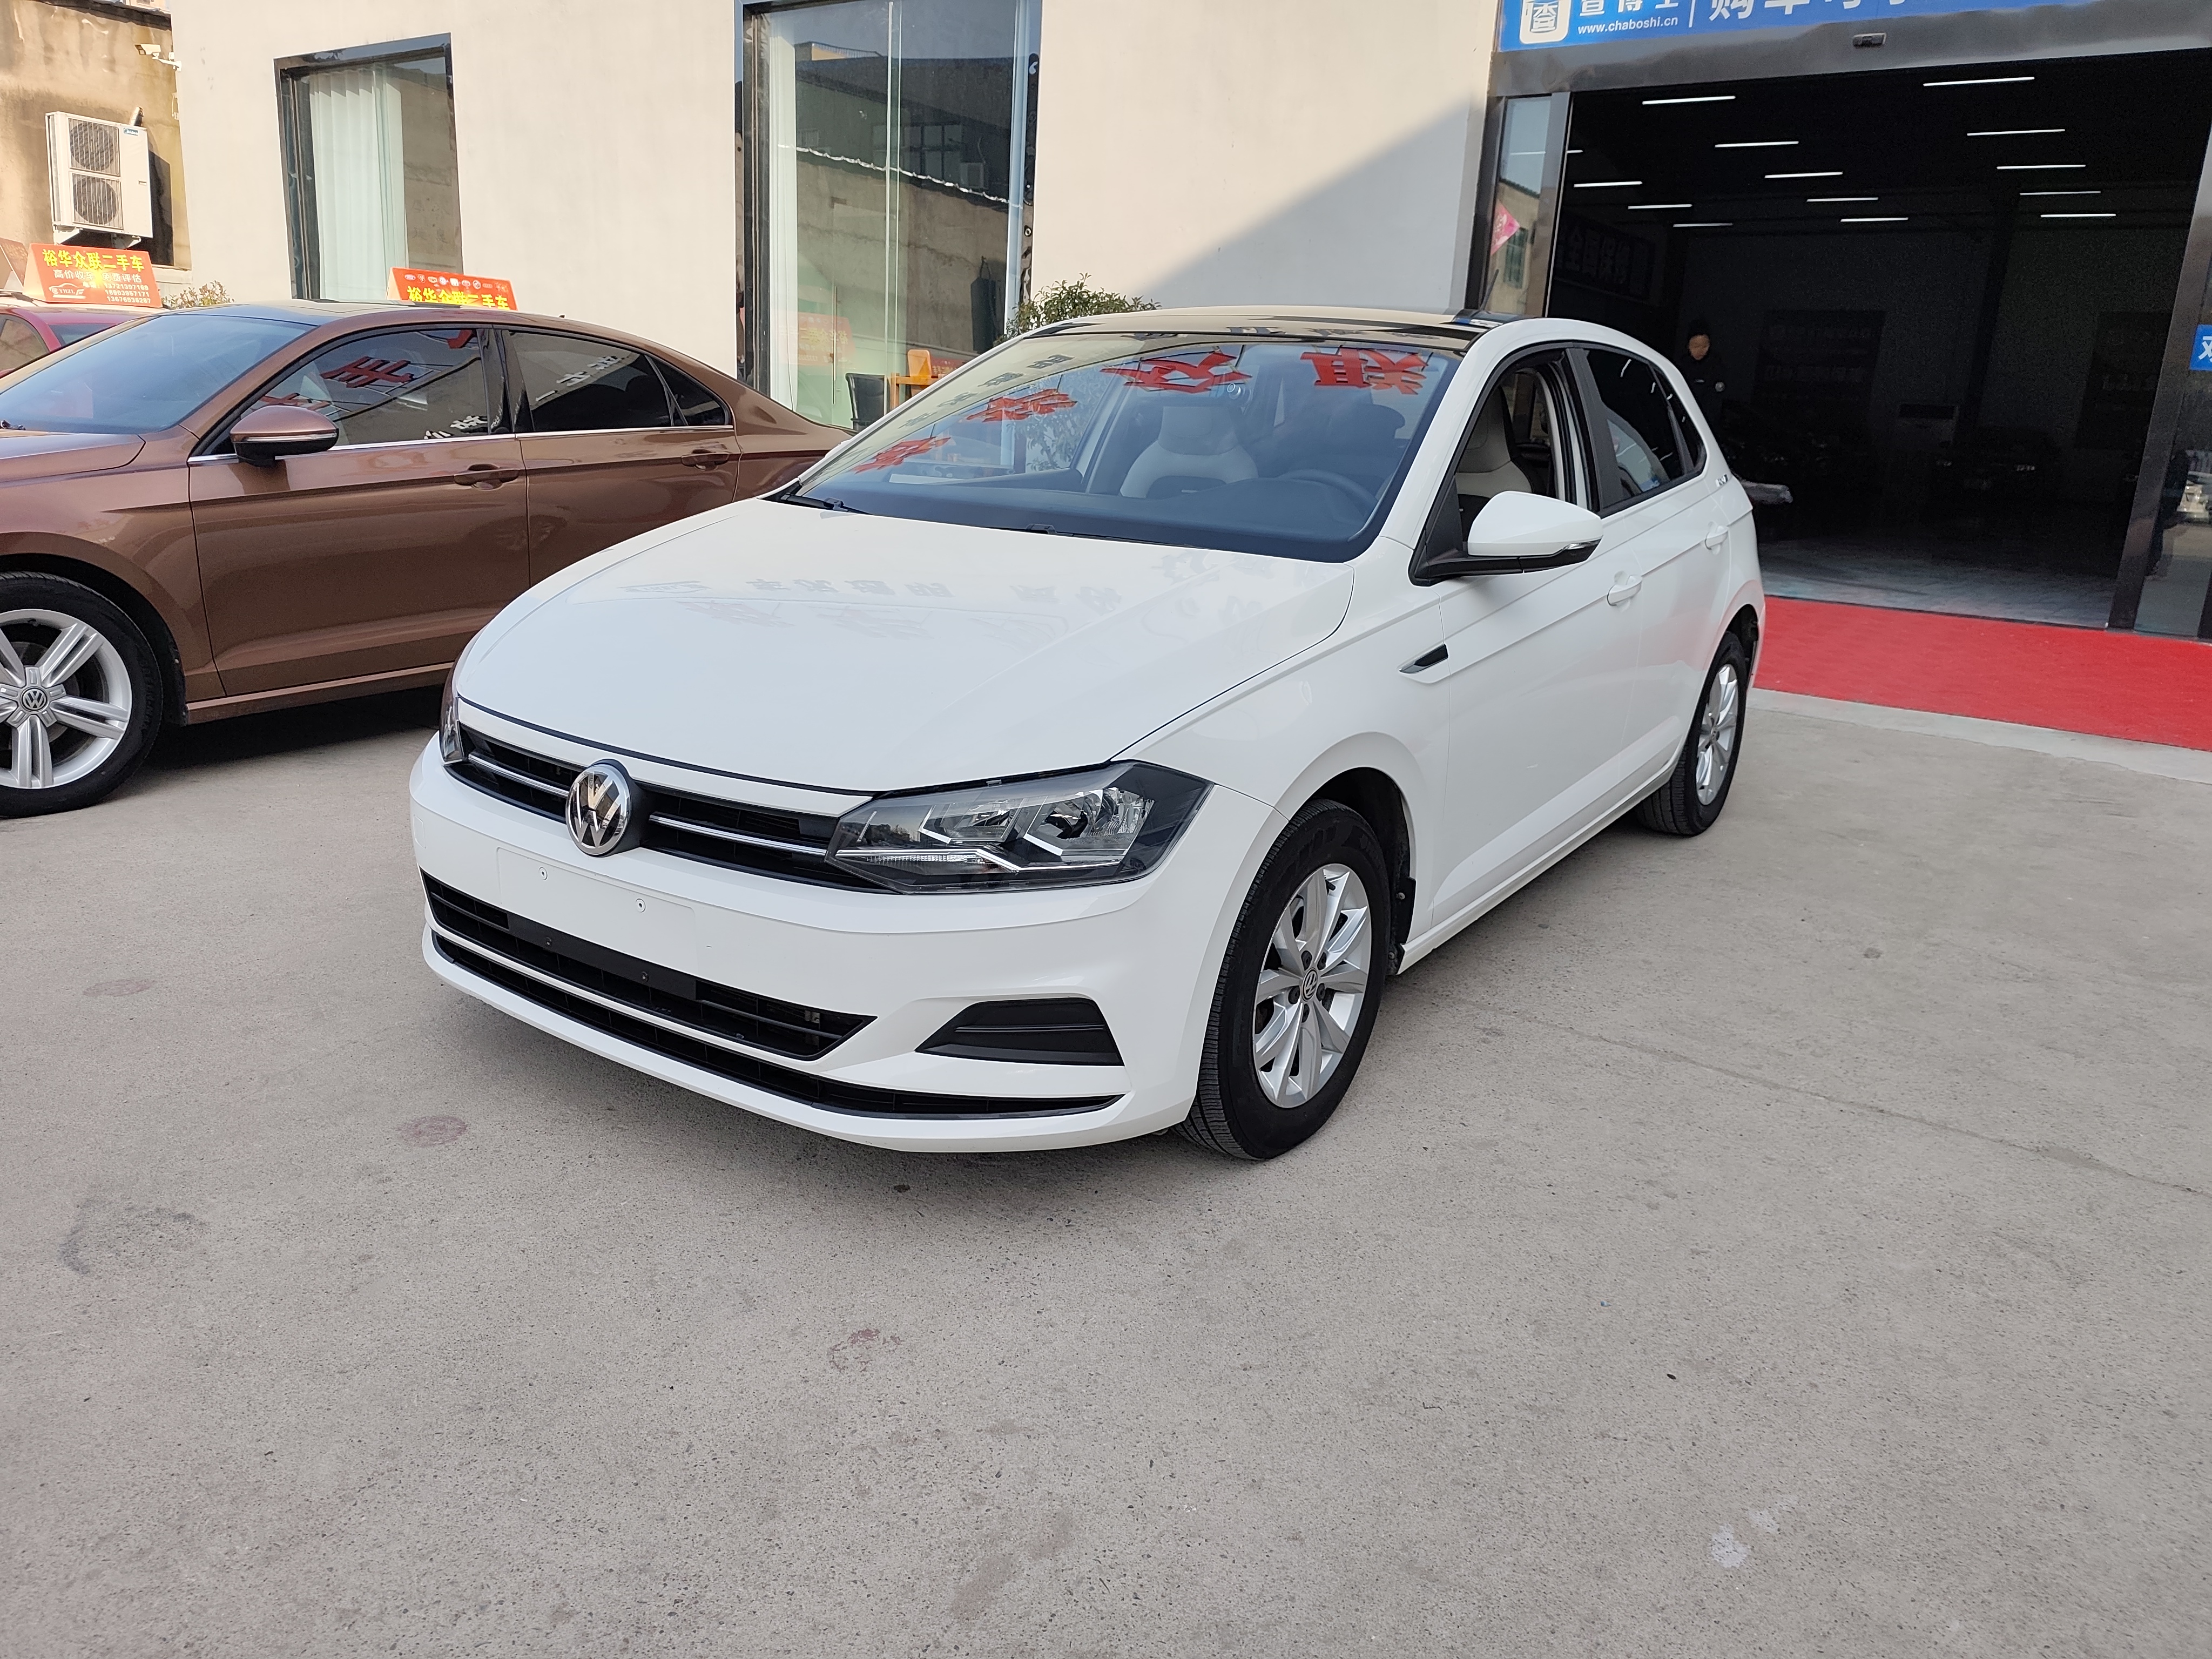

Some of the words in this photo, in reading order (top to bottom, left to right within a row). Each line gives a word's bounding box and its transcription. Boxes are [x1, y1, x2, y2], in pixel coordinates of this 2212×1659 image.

[1577, 16, 1678, 35] www.chaboshi.cn
[42, 248, 144, 272] 裕华众联二手车
[52, 269, 96, 280] 高价收车
[102, 272, 142, 283] 免费评估
